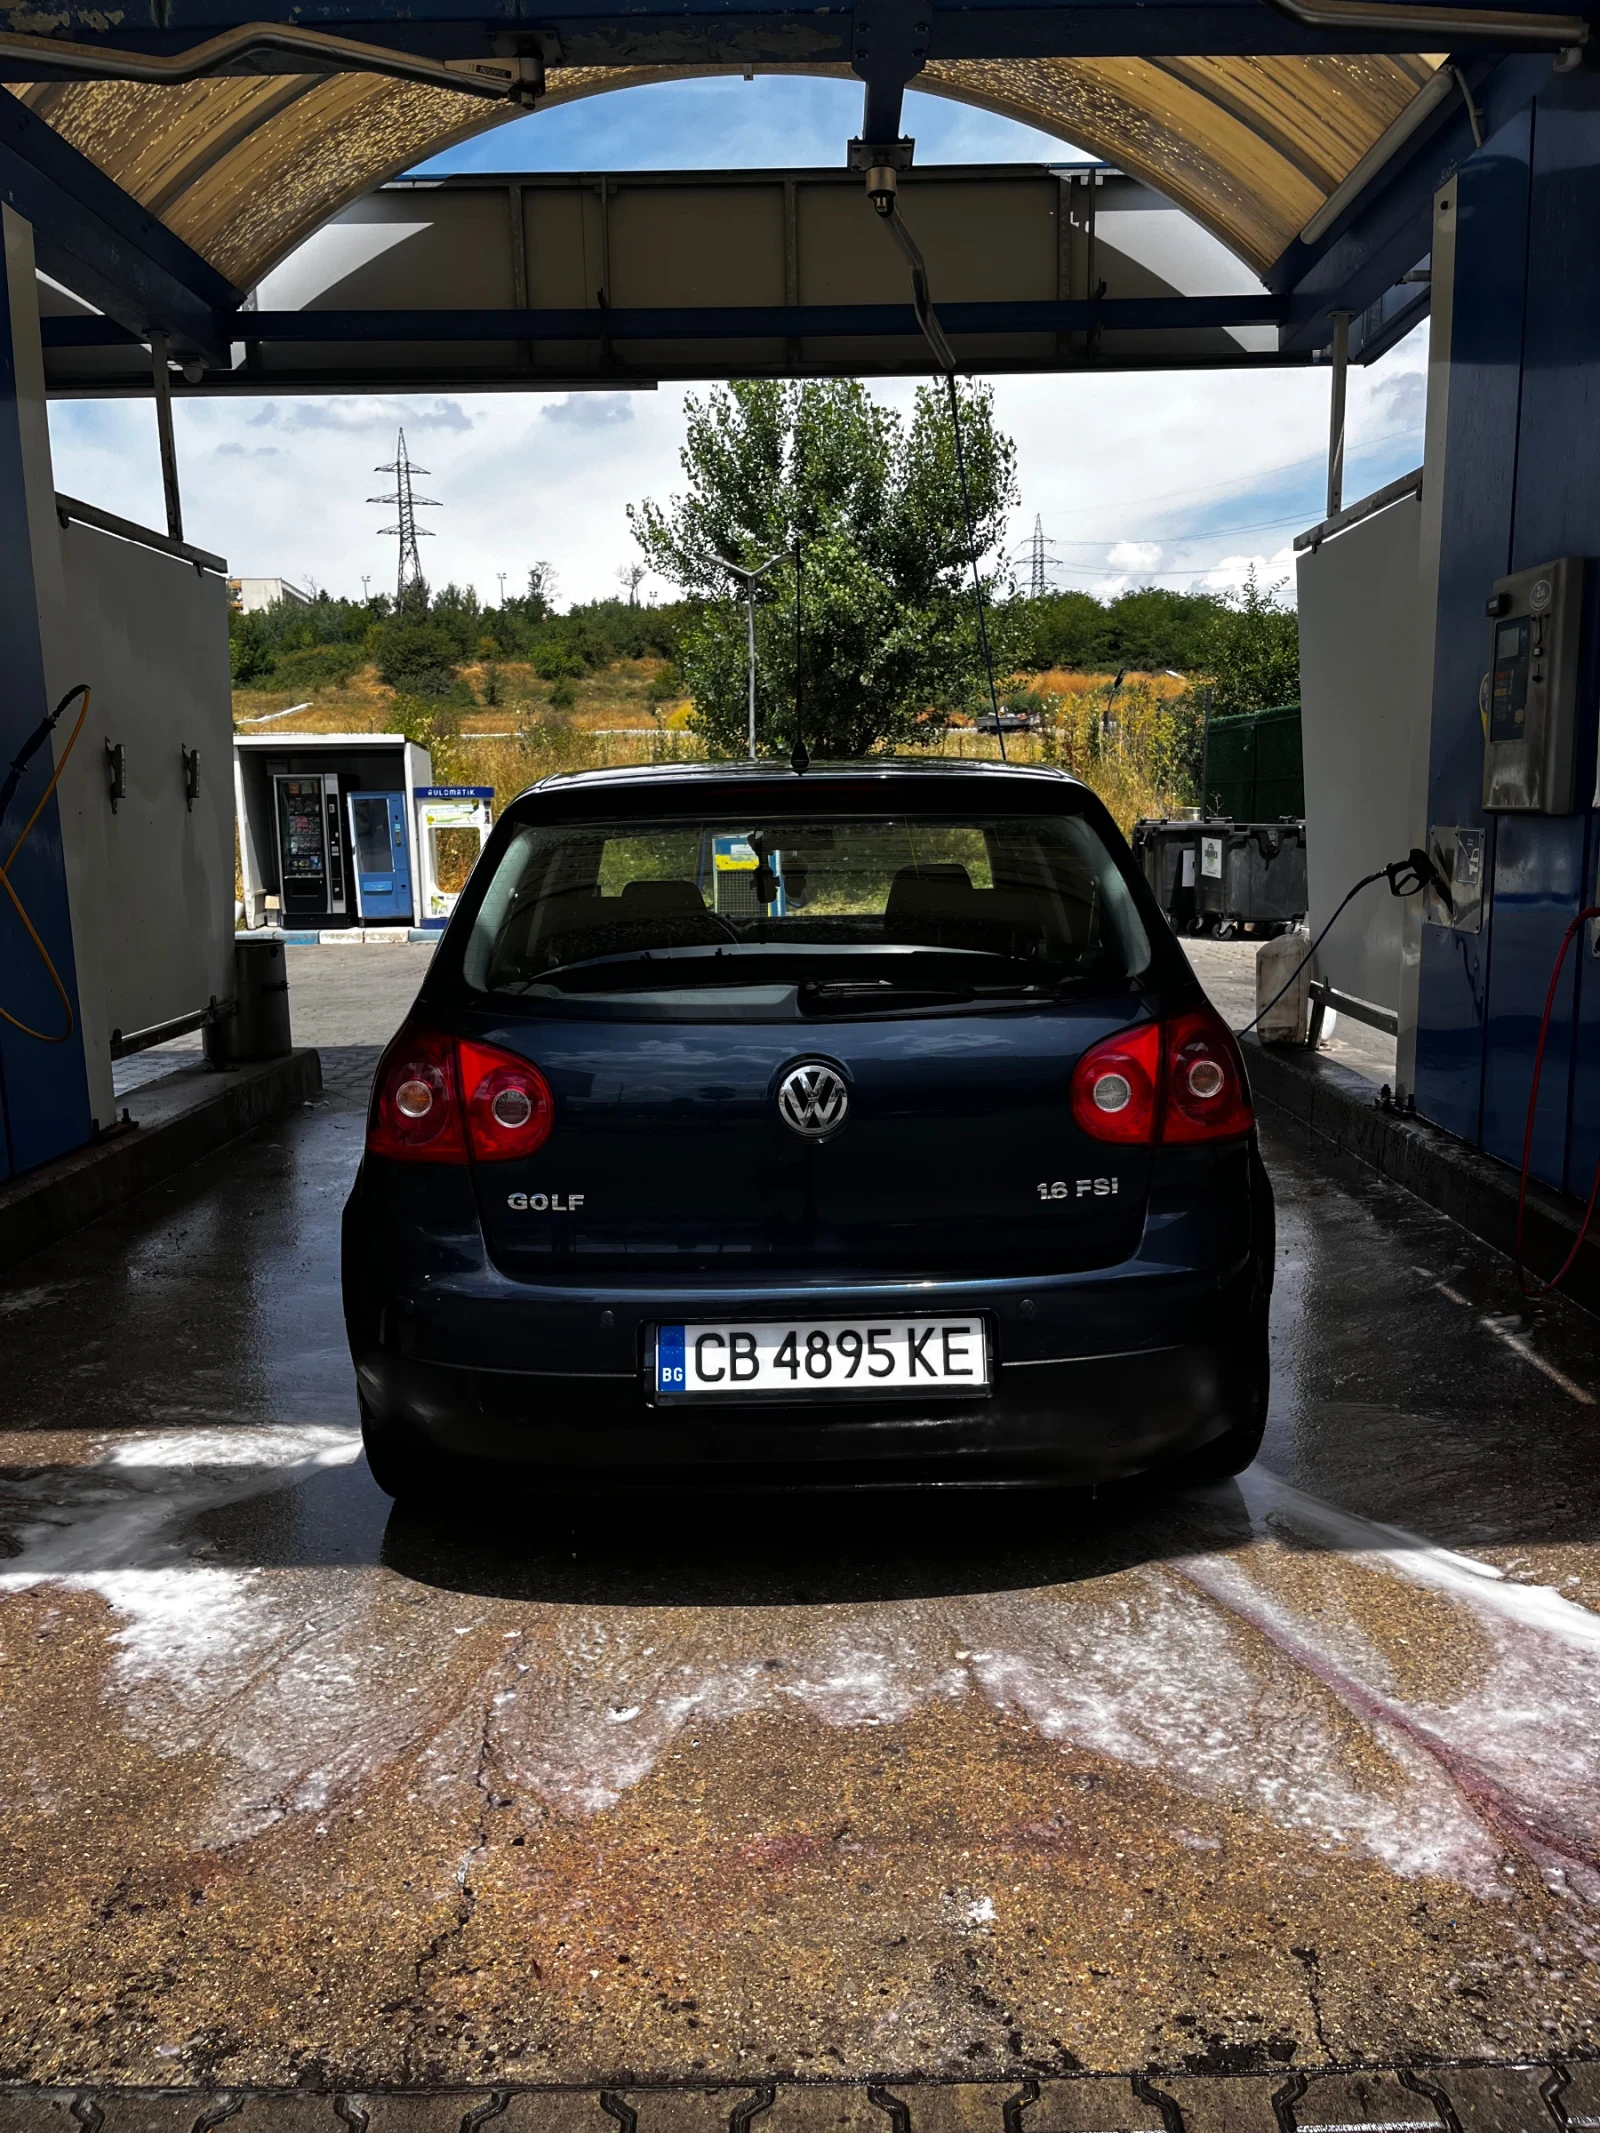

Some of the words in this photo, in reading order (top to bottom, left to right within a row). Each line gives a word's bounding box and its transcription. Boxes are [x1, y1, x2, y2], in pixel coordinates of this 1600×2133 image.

[1076, 1177, 1118, 1197] FSI
[507, 1192, 585, 1212] GOLF
[694, 1331, 760, 1383] CB
[772, 1328, 896, 1381] 4895
[906, 1326, 974, 1378] KE
[662, 1367, 684, 1382] BG
